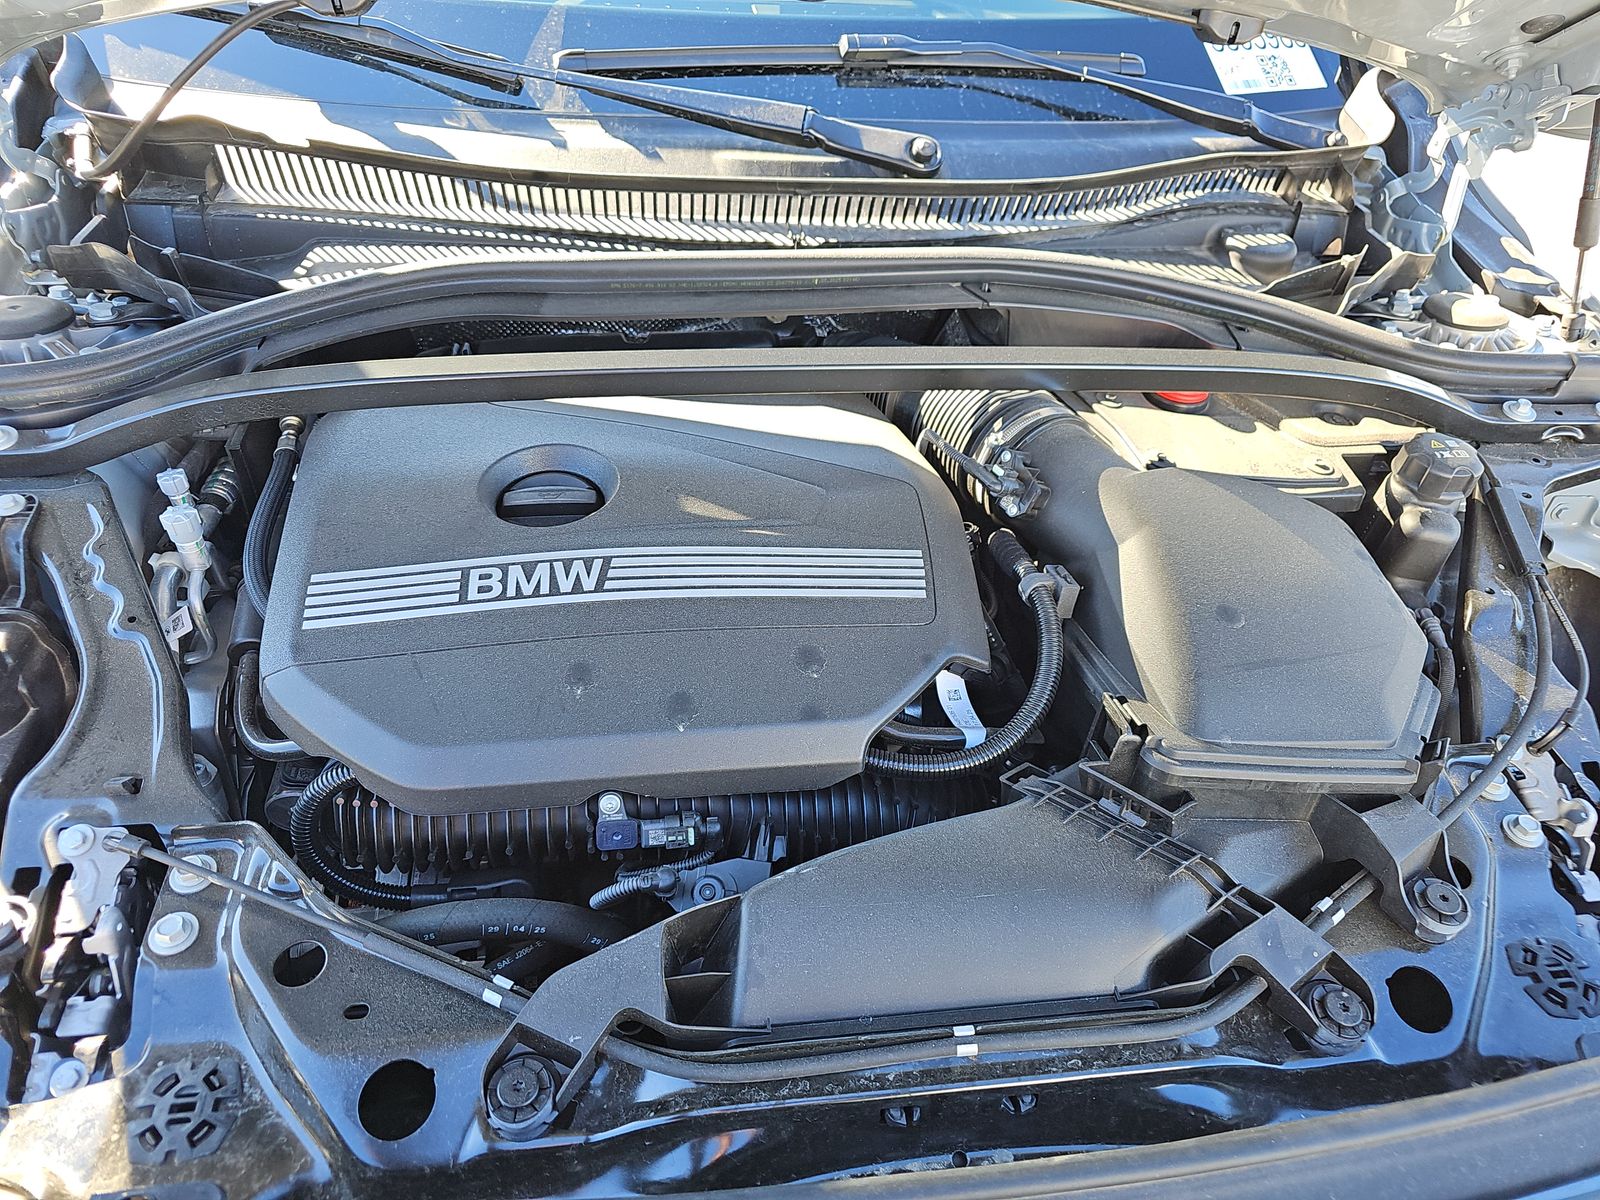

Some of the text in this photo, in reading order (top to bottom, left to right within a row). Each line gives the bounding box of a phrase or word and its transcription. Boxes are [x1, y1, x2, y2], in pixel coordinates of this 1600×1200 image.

[467, 558, 604, 601] BMW
[513, 925, 525, 933] 04
[534, 926, 546, 934] 25
[423, 932, 436, 941] 25
